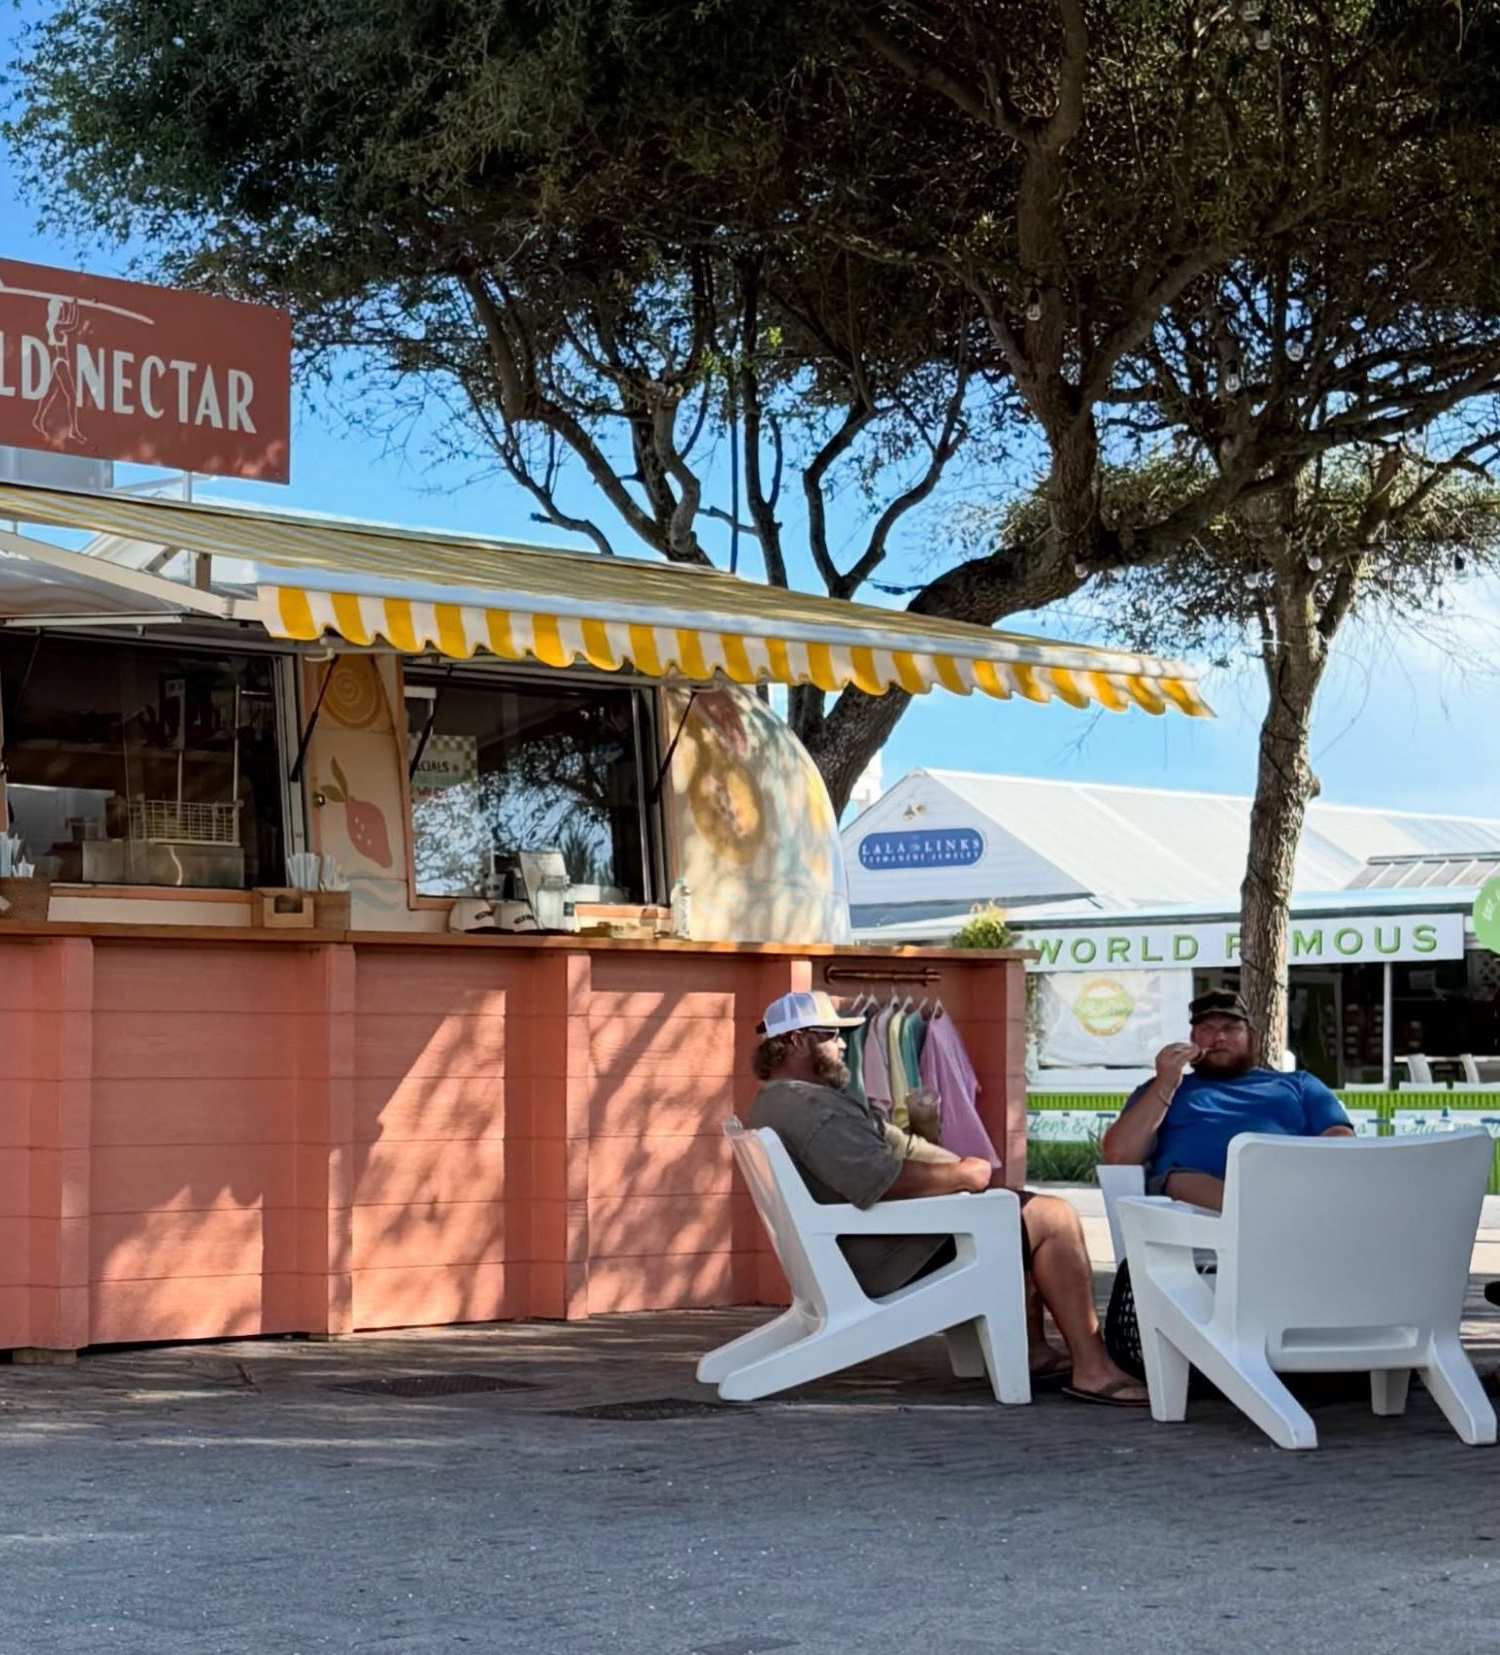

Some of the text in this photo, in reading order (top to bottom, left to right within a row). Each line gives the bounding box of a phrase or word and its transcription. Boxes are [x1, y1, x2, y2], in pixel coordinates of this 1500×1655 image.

[76, 344, 257, 434] NECTAR
[861, 838, 980, 856] LALA LINKS
[1027, 924, 1438, 965] WORLD FMOUS
